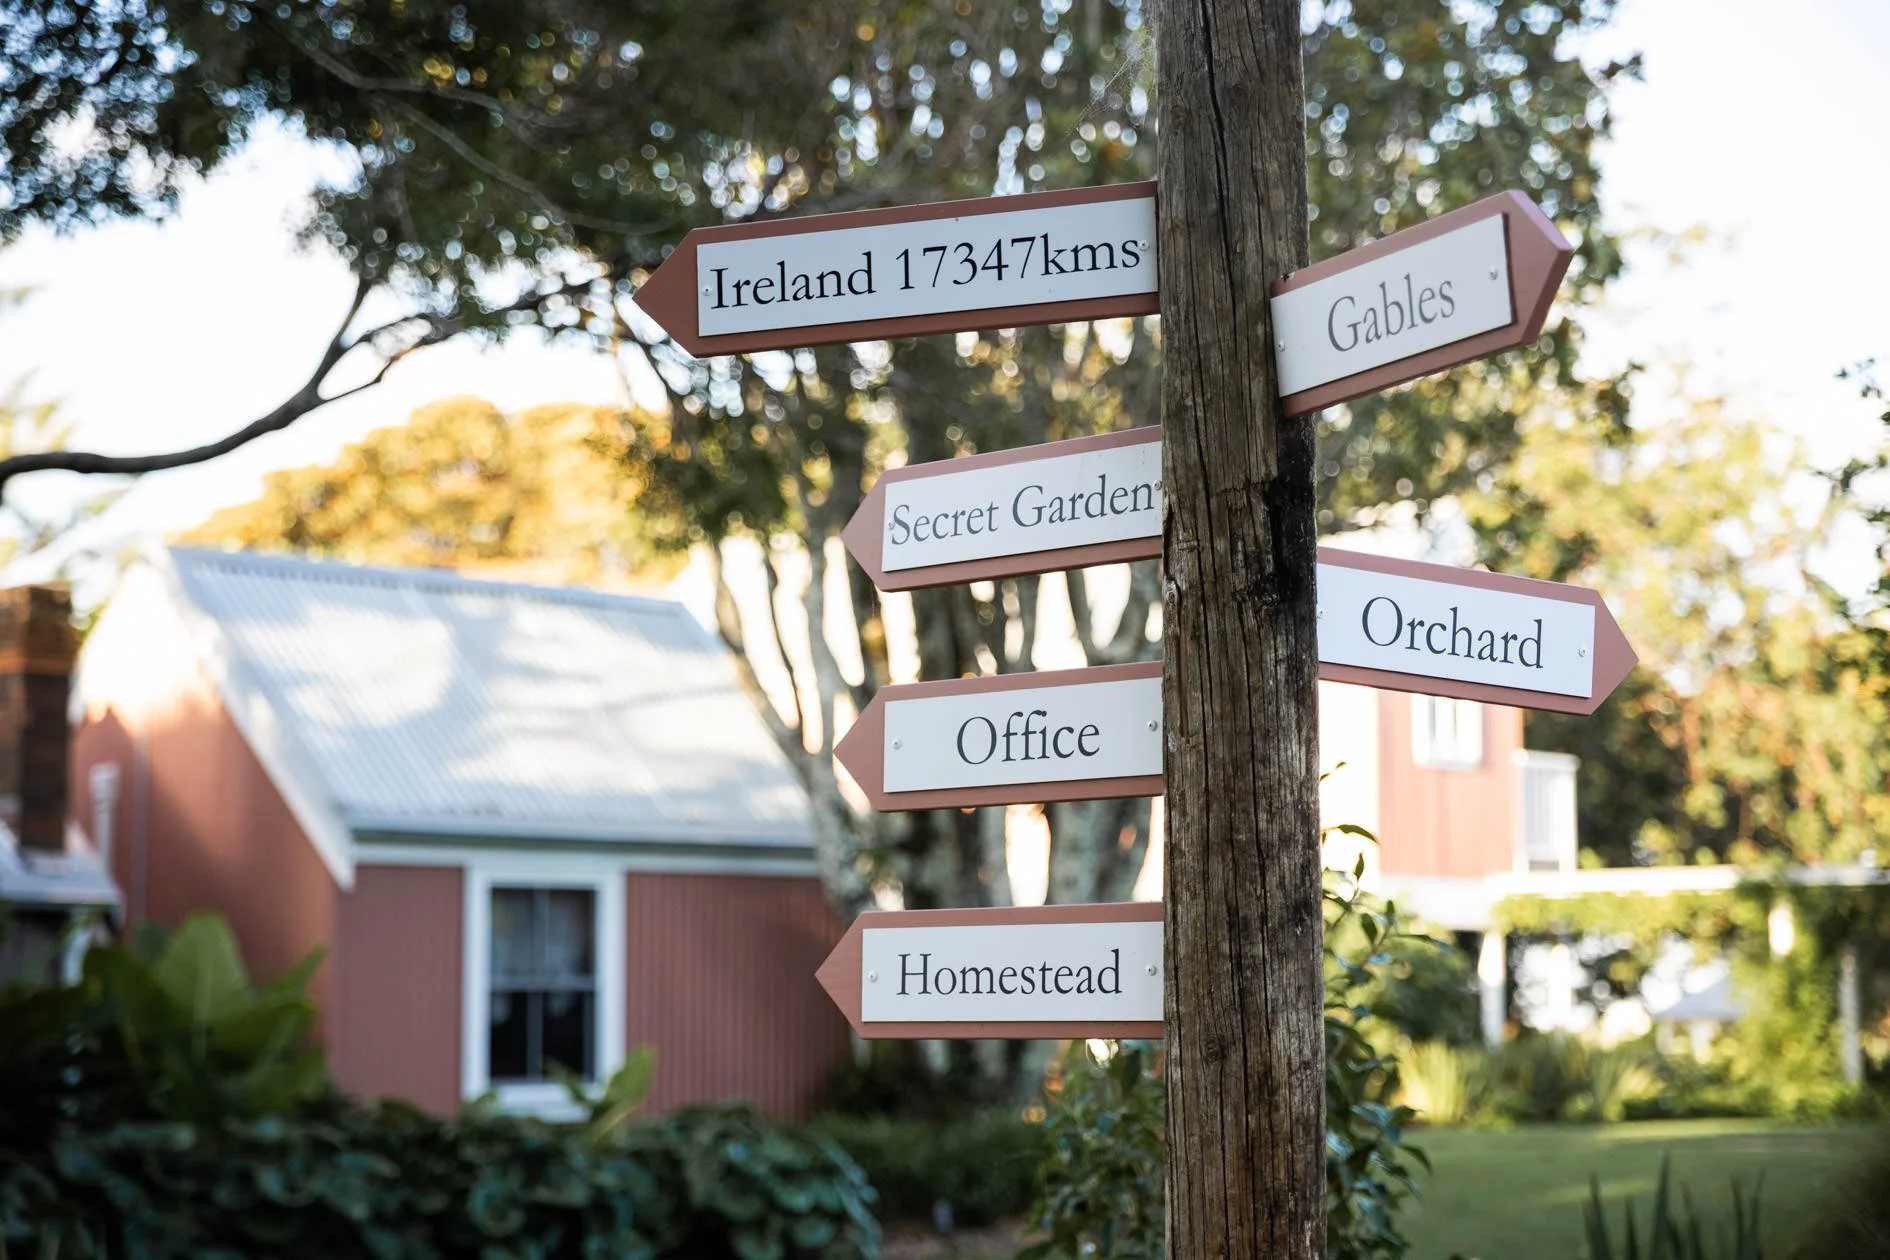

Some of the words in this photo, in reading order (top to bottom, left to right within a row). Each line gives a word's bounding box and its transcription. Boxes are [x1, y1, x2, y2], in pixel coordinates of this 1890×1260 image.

[709, 251, 877, 310] Ireland
[896, 232, 1141, 291] 17347kms
[1327, 273, 1455, 353] Gables
[891, 501, 999, 546] Secret
[1012, 474, 1155, 528] Garden
[1361, 596, 1544, 669] Orchard
[956, 709, 1101, 765] Office
[897, 948, 1123, 997] Homestead
